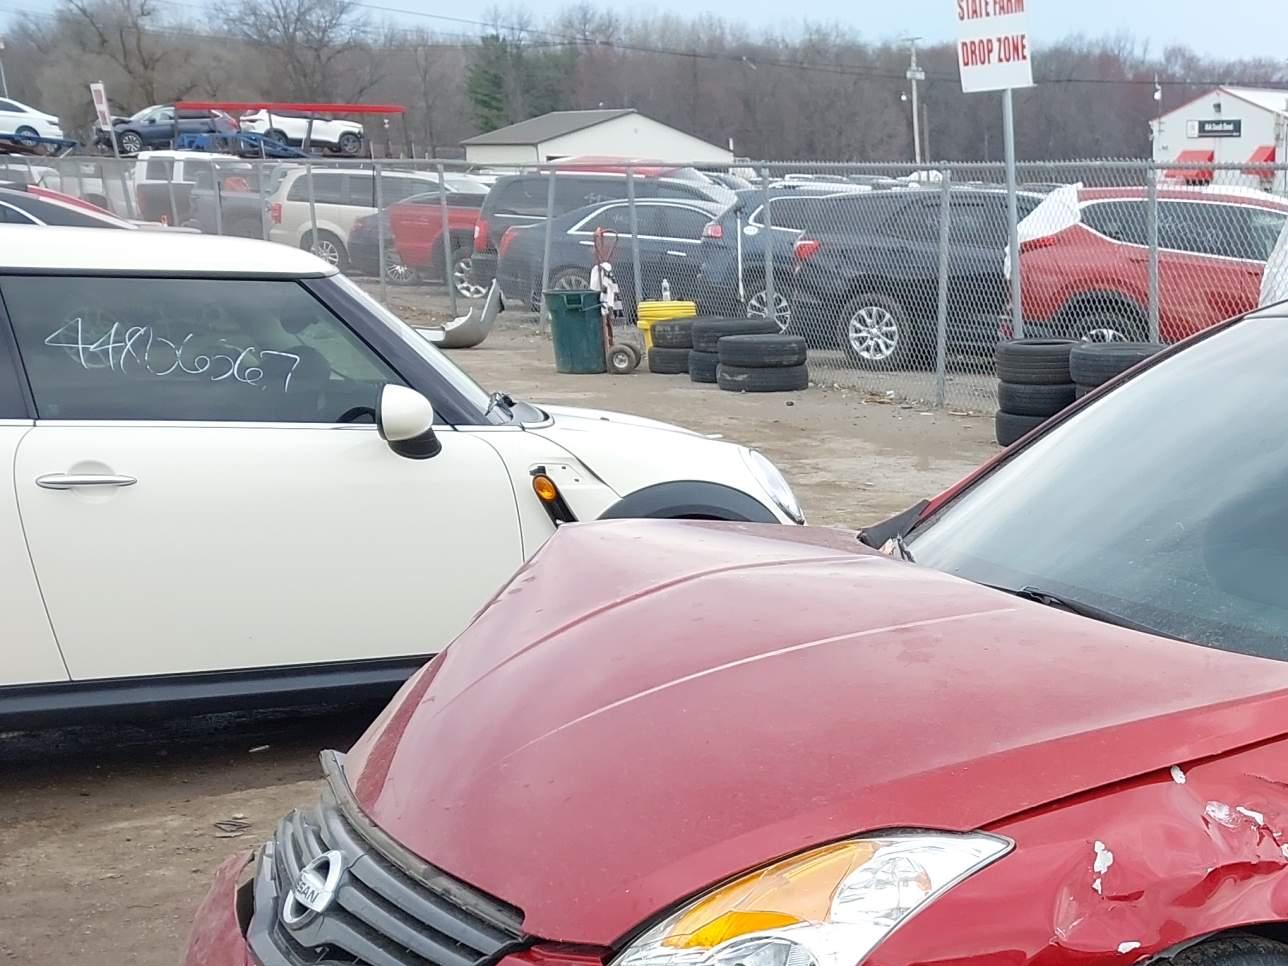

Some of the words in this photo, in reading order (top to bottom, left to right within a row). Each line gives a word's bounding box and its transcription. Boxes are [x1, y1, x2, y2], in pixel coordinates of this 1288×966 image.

[958, 0, 990, 20] STATE
[961, 39, 993, 66] DROP
[997, 34, 1027, 62] ZONE
